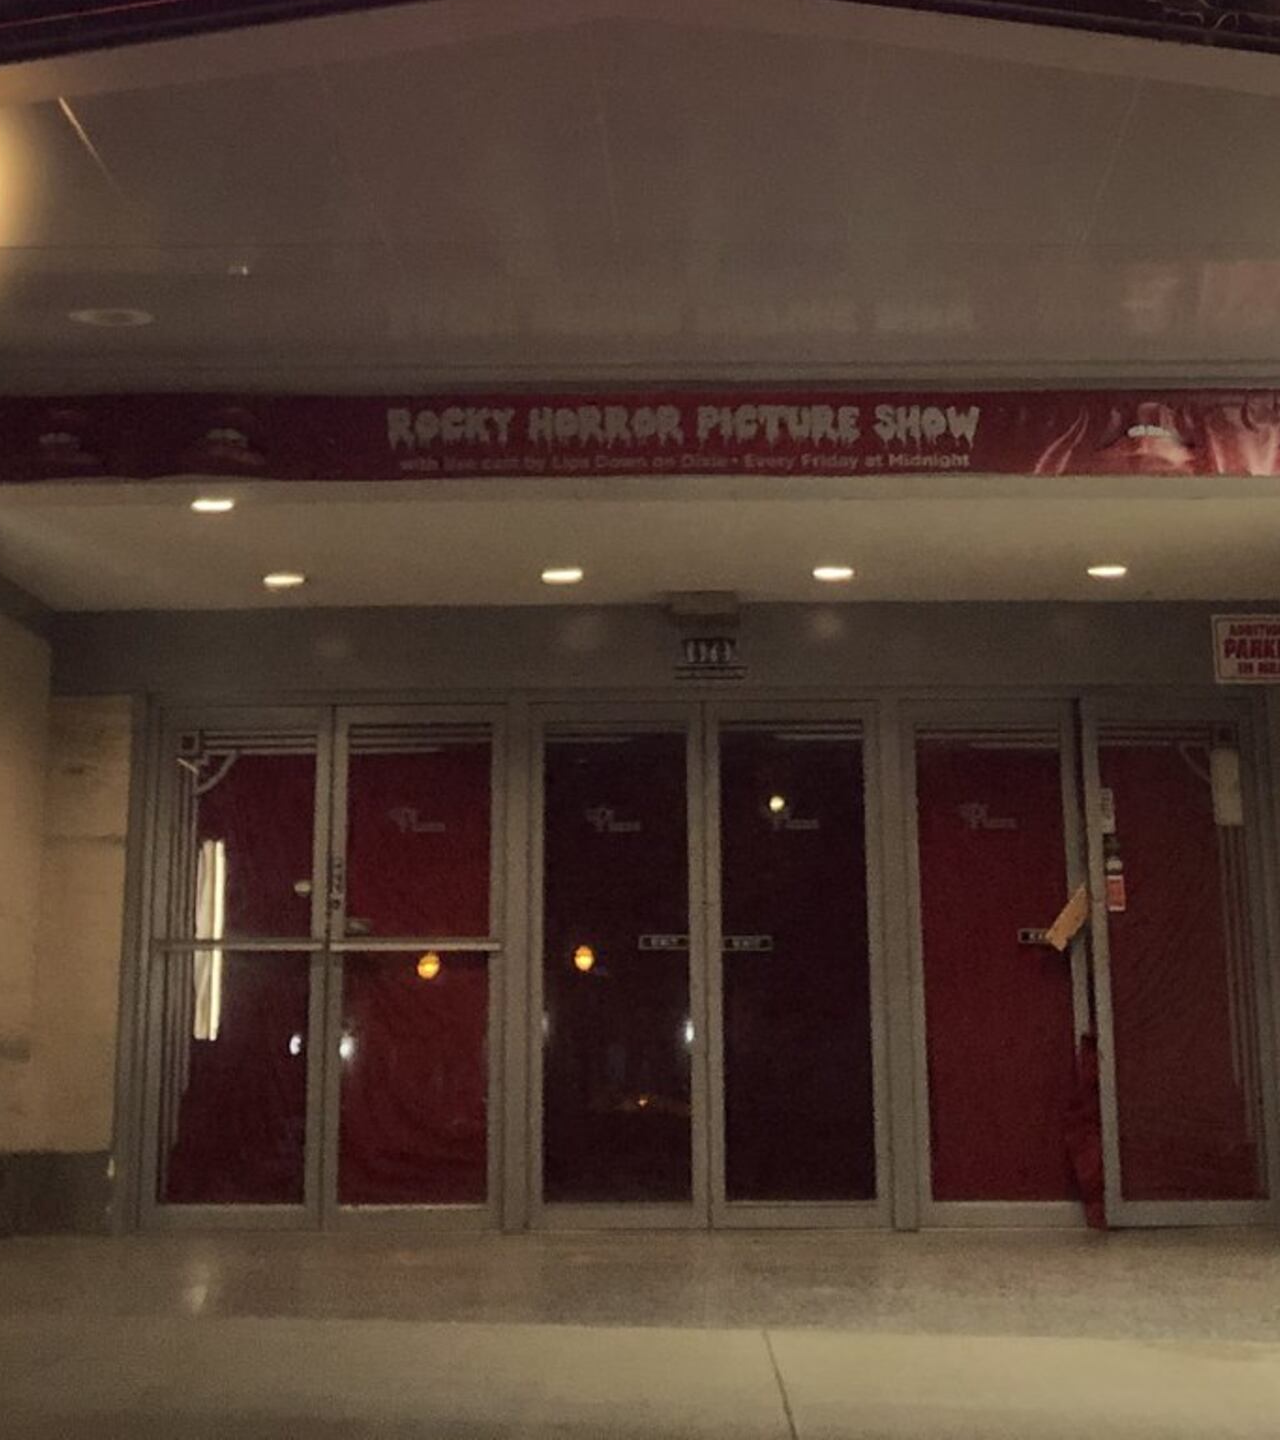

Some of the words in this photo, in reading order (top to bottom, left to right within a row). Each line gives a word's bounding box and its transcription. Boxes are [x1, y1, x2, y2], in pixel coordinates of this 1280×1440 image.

[387, 406, 516, 450] ROCKY
[528, 405, 684, 449] HORROR
[697, 404, 861, 449] PICTURE
[874, 404, 980, 450] SHOW
[745, 454, 794, 472] Every
[801, 453, 857, 471] Friday
[888, 453, 971, 470] Midnight
